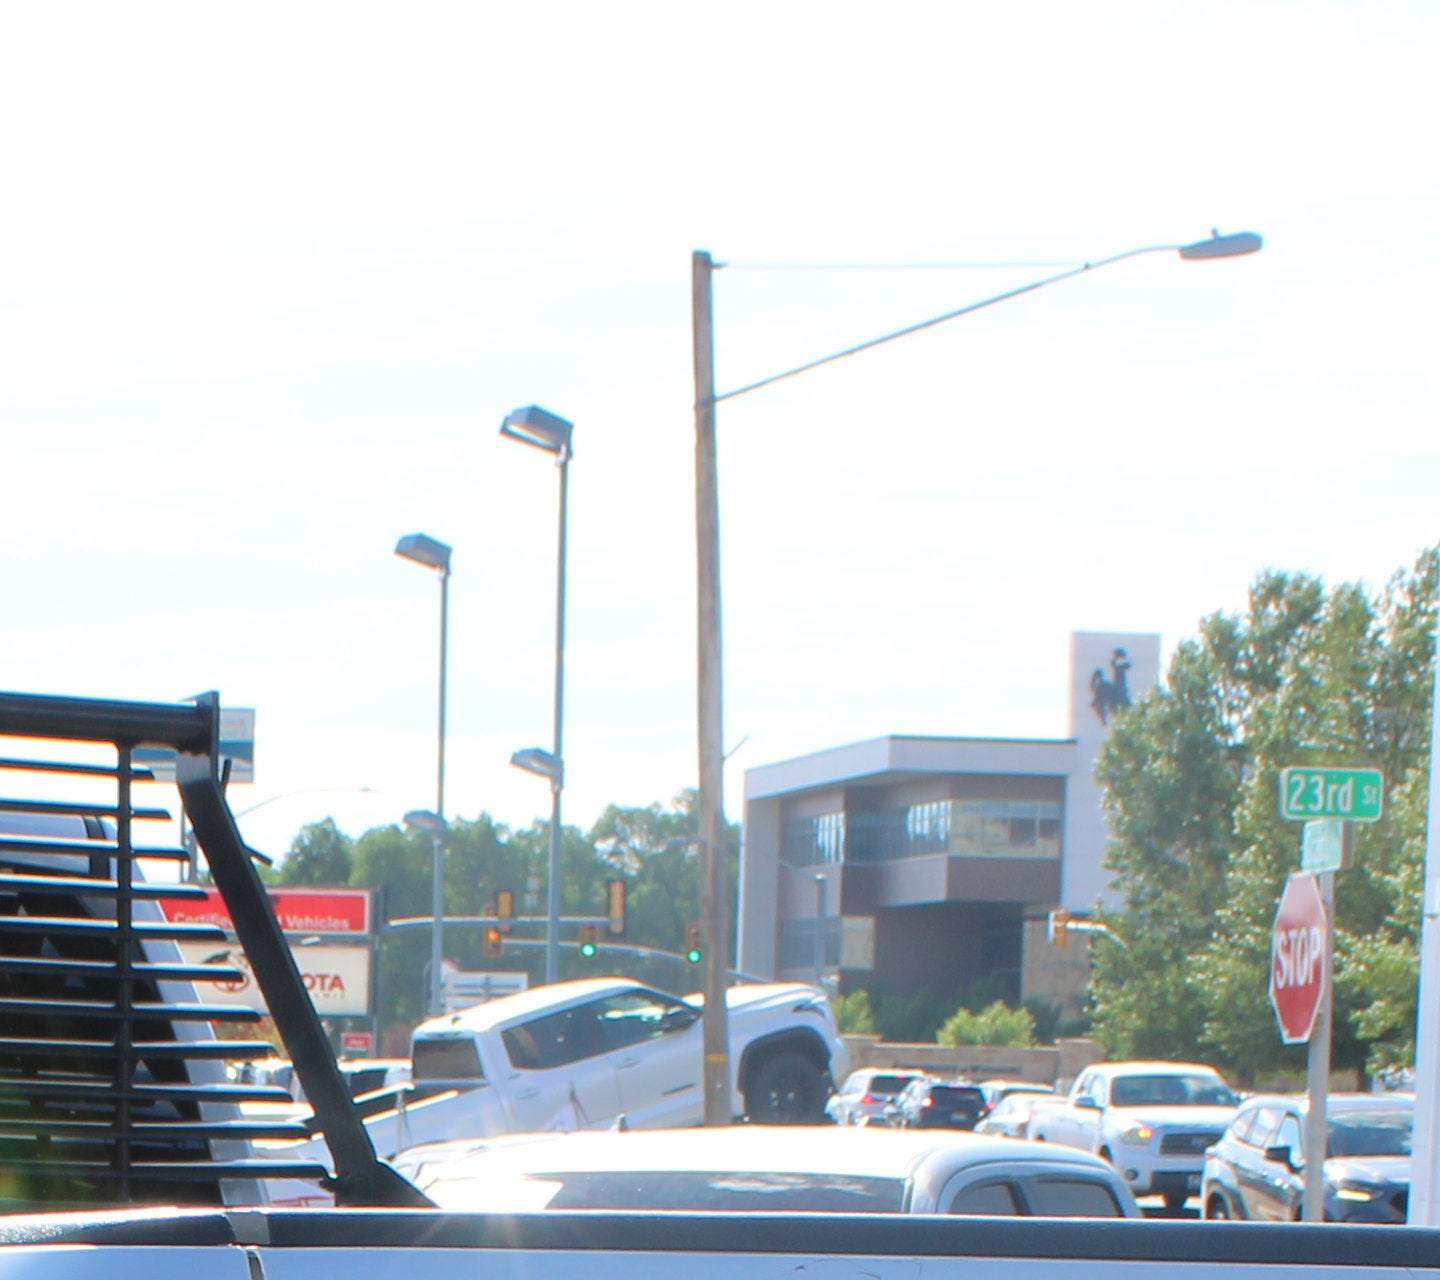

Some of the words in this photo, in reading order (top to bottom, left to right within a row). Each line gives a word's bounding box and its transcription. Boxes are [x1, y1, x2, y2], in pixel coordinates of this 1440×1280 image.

[1288, 773, 1354, 813] 23rd
[285, 914, 350, 930] Vehicles
[1275, 926, 1321, 990] STOP
